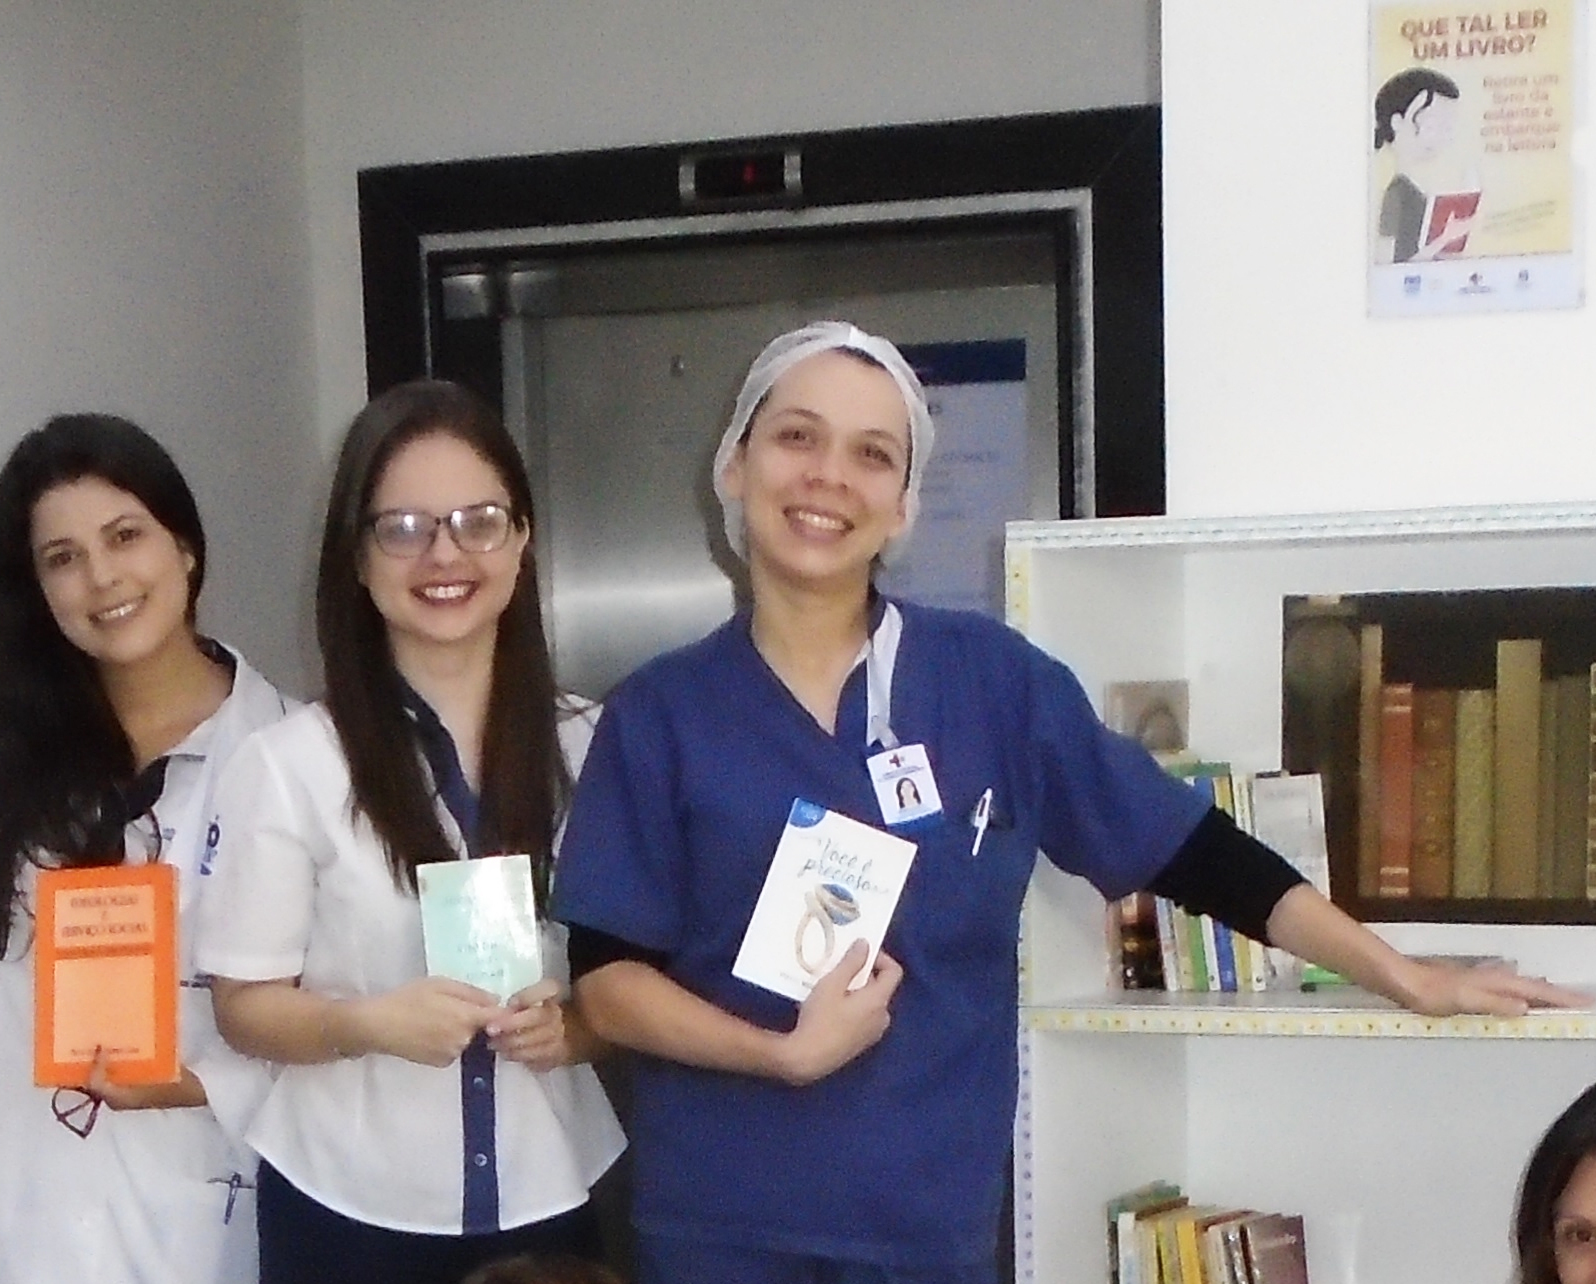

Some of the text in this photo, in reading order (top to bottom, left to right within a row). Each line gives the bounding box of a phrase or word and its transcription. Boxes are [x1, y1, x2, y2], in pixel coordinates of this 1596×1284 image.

[1400, 8, 1548, 41] QUE TAL LER
[1413, 34, 1536, 60] UM LIVRO?
